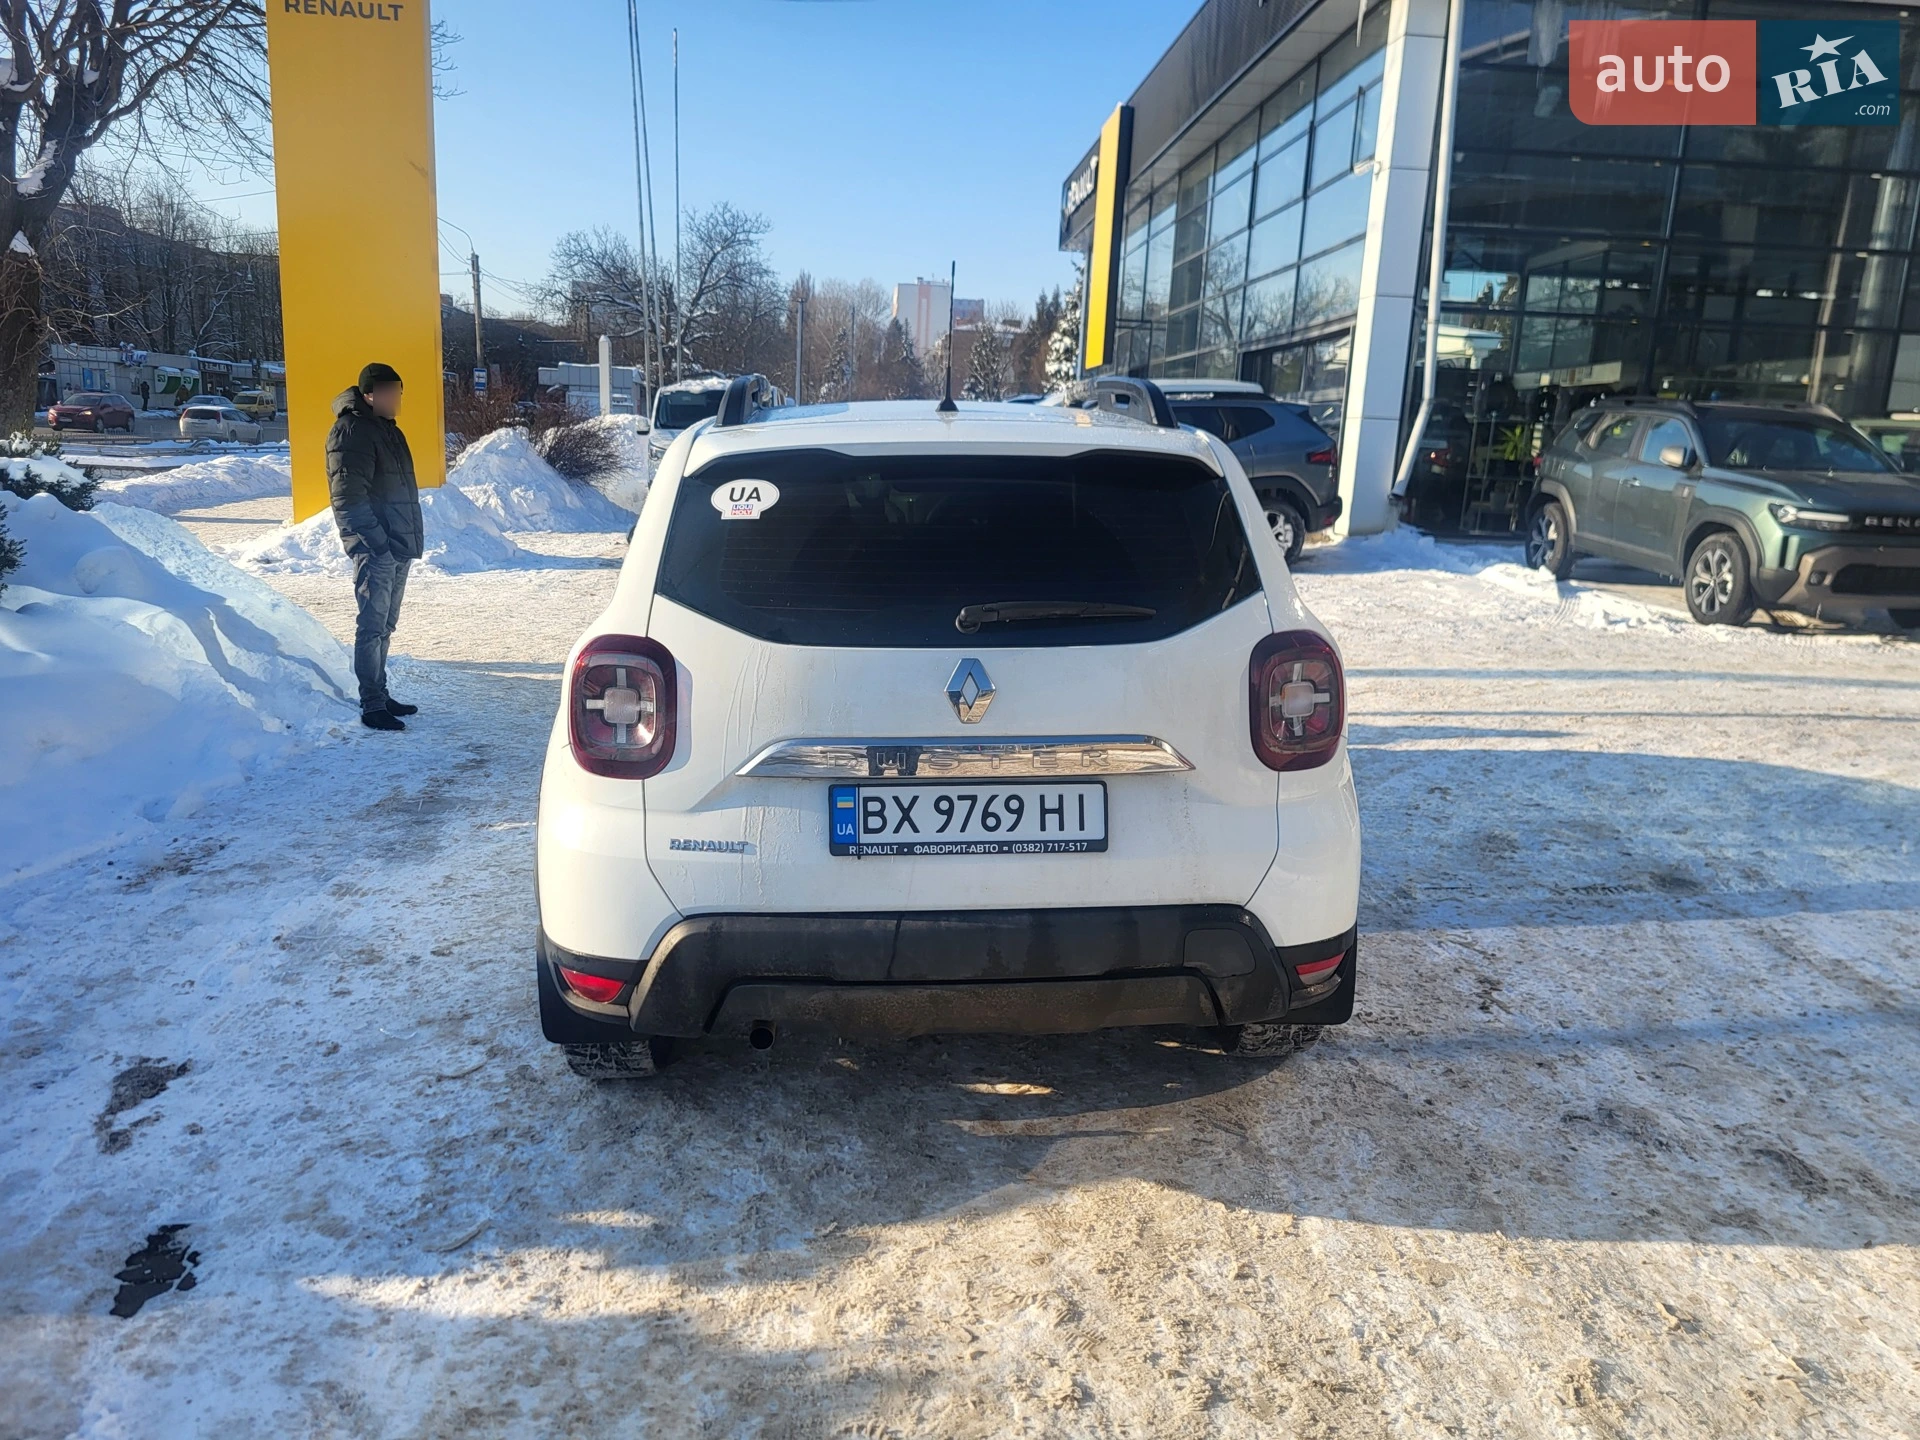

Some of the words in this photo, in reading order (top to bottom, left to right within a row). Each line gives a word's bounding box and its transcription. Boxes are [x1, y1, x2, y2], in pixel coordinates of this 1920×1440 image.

[284, 0, 404, 21] RENAULT
[728, 486, 762, 502] UA
[862, 795, 920, 834] BX
[933, 794, 1026, 834] 9769
[1039, 793, 1085, 832] HI
[836, 823, 855, 836] UA
[669, 838, 749, 854] RENAULT
[849, 845, 899, 854] RENAULT
[913, 843, 999, 854] ФАВОРИТ-АВТО
[1012, 842, 1045, 853] (0382)
[1046, 842, 1088, 851] 717-517
